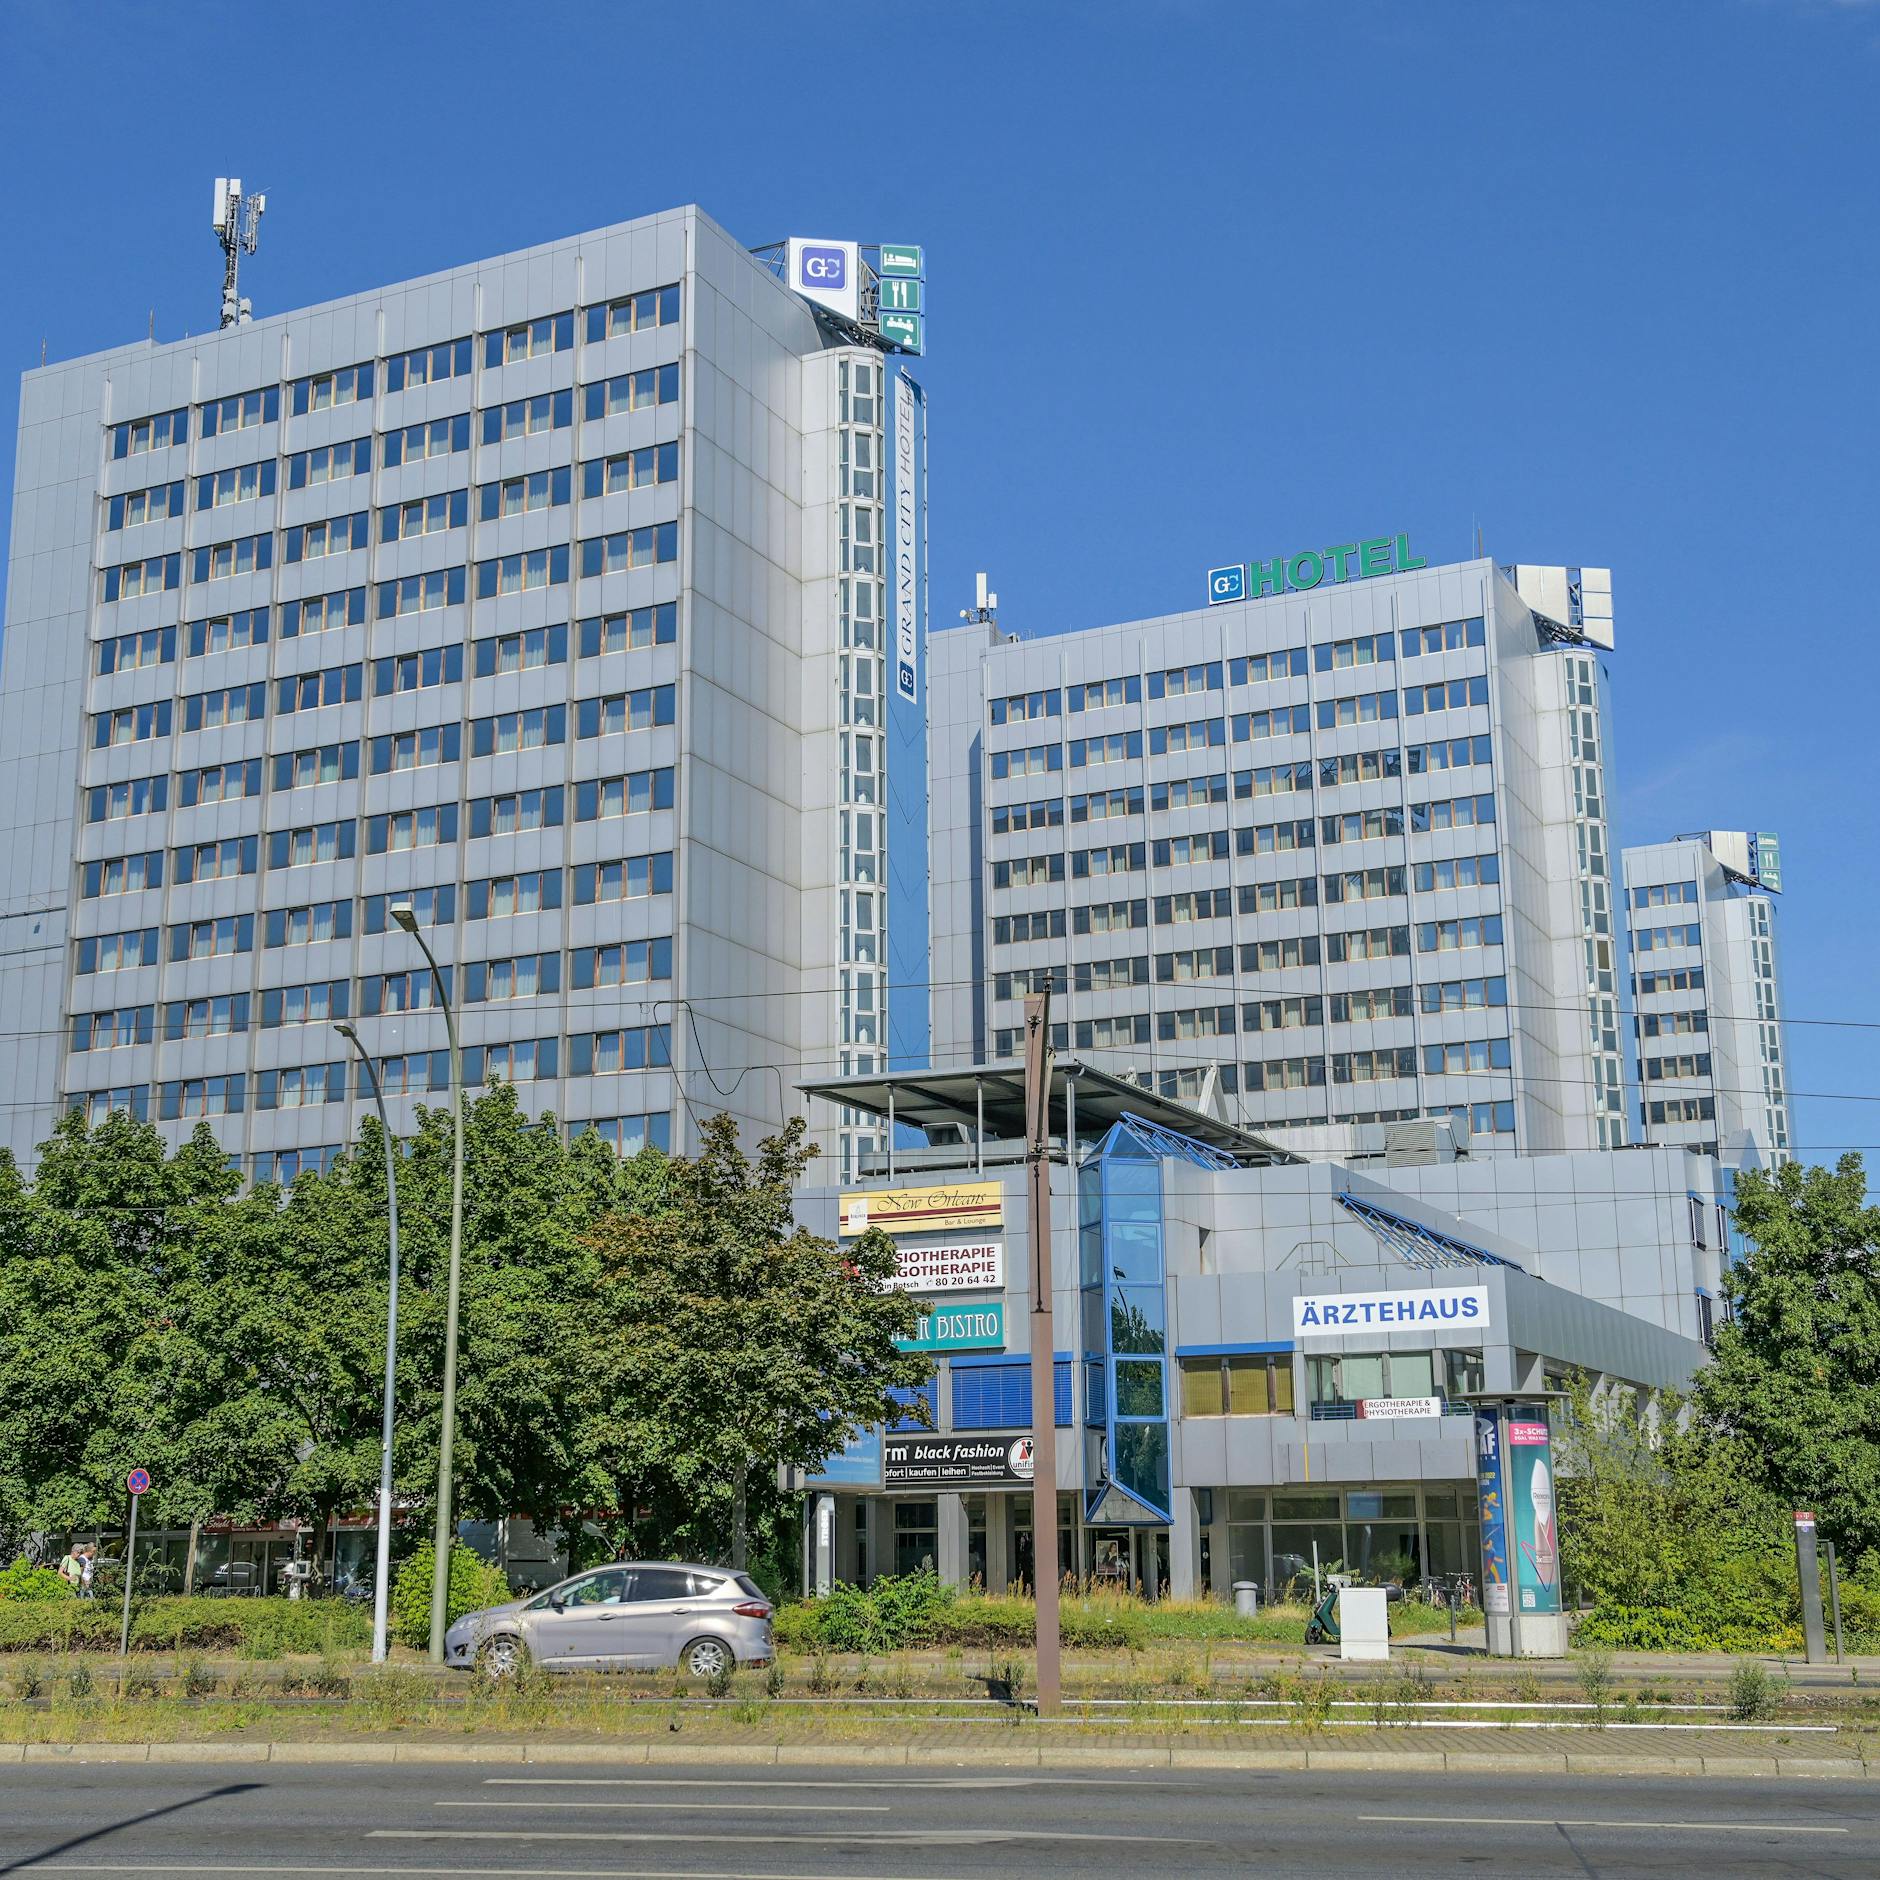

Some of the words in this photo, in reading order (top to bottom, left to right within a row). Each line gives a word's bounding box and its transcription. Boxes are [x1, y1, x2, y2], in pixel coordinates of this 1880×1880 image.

[900, 395, 911, 474] HOTEL
[901, 485, 912, 547] CITY
[1249, 532, 1427, 598] HOTEL
[901, 555, 912, 656] GRAND
[877, 1193, 922, 1212] New
[928, 1190, 987, 1208] Orleans
[944, 1217, 955, 1225] Bar
[957, 1217, 962, 1225] &
[963, 1217, 987, 1226] Lounge
[895, 1246, 995, 1264] SIOTHERAPIE
[896, 1261, 995, 1278] GOTHERAPIE
[935, 1277, 948, 1286] 80
[951, 1276, 964, 1286] 20
[967, 1275, 980, 1285] 64
[983, 1274, 996, 1284] 42
[1301, 1297, 1479, 1326] ÄRZTEHAUS
[937, 1312, 998, 1338] BISTRO
[1364, 1400, 1423, 1409] ERGOTHERAPIE
[1364, 1407, 1431, 1416] PHYSIOTHERAPIE
[914, 1445, 951, 1460] black
[952, 1443, 1005, 1461] fashion
[885, 1468, 904, 1478] ofort
[908, 1467, 937, 1477] kaufen
[941, 1467, 966, 1476] leihen
